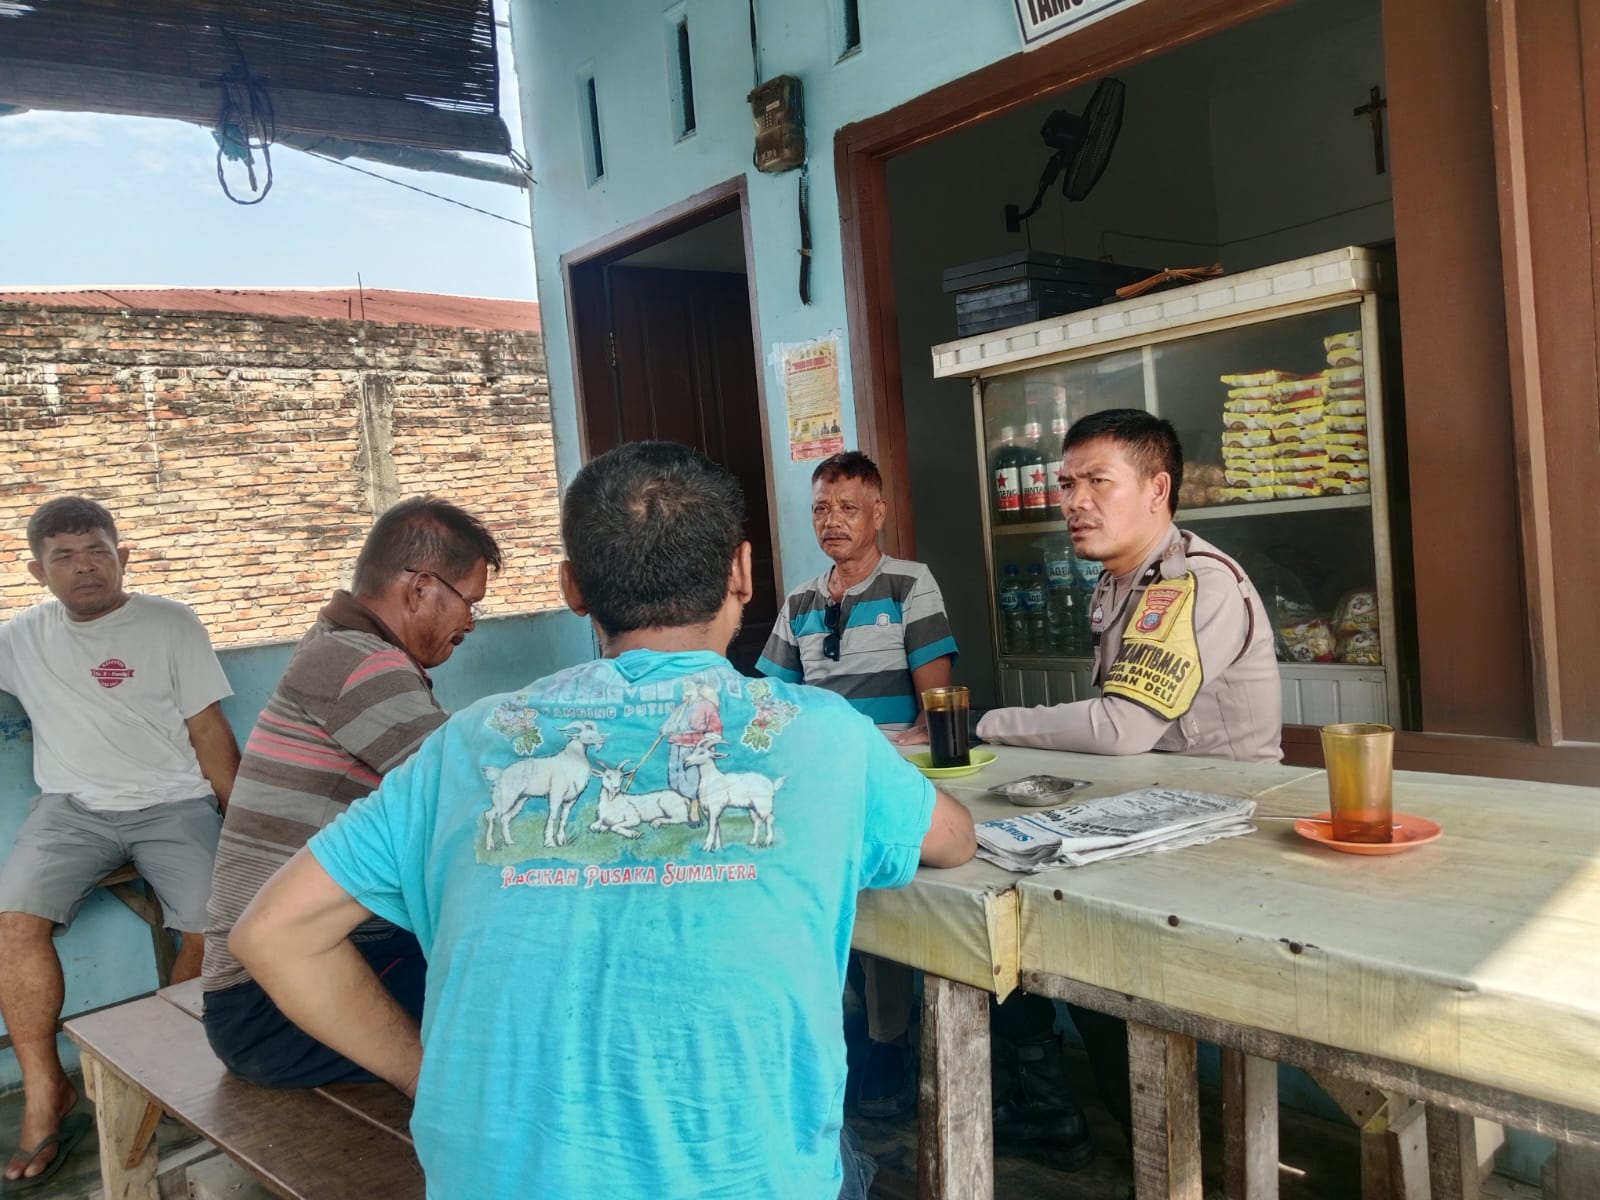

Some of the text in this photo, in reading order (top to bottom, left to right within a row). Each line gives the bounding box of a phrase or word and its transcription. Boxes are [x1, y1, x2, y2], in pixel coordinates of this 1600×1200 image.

[1129, 665, 1178, 692] BANGUN
[1144, 682, 1173, 702] DELI
[583, 864, 656, 889] PUSAKA
[661, 862, 758, 888] SUMATERA
